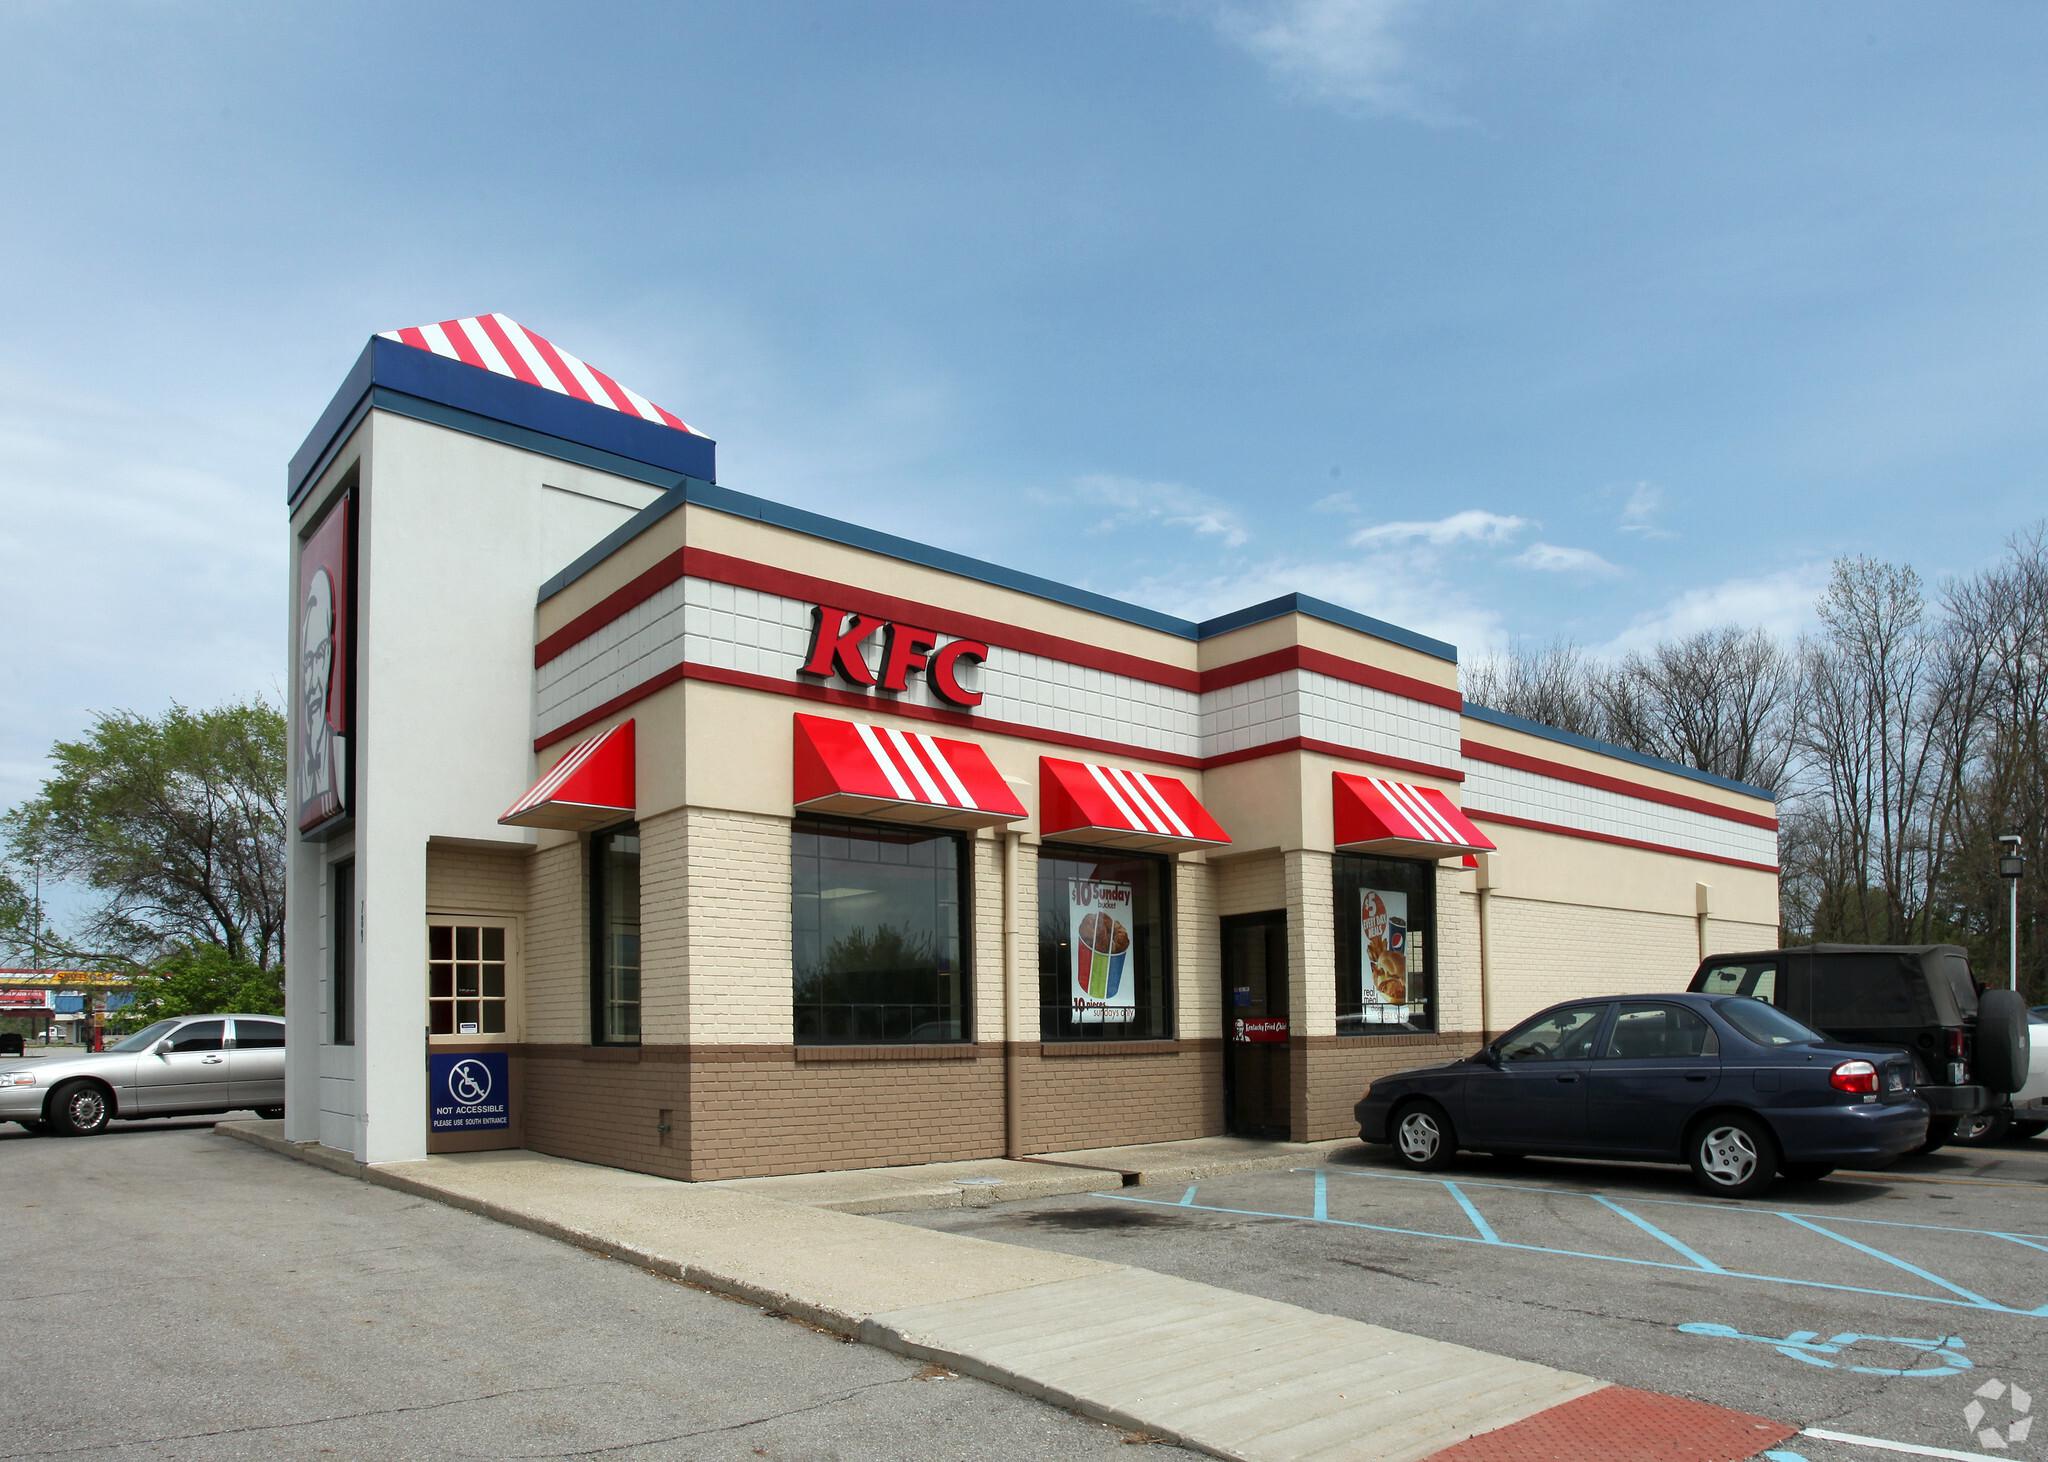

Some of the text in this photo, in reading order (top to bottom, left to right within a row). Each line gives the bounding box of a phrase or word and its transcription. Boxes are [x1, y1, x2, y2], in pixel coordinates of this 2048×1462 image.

[797, 605, 989, 709] KFC
[1072, 882, 1130, 906] $10 Sunday
[1098, 899, 1116, 909] bucket
[1365, 892, 1377, 917] $5
[1364, 985, 1375, 996] real
[1364, 993, 1378, 1004] meal
[1073, 997, 1085, 1012] 10
[1245, 1022, 1264, 1032] Kentucky
[1264, 1022, 1275, 1032] Fried
[436, 1105, 504, 1115] NOT ACCESSIBLE
[465, 1118, 482, 1126] SOUTH
[482, 1117, 507, 1125] ENTRANCE
